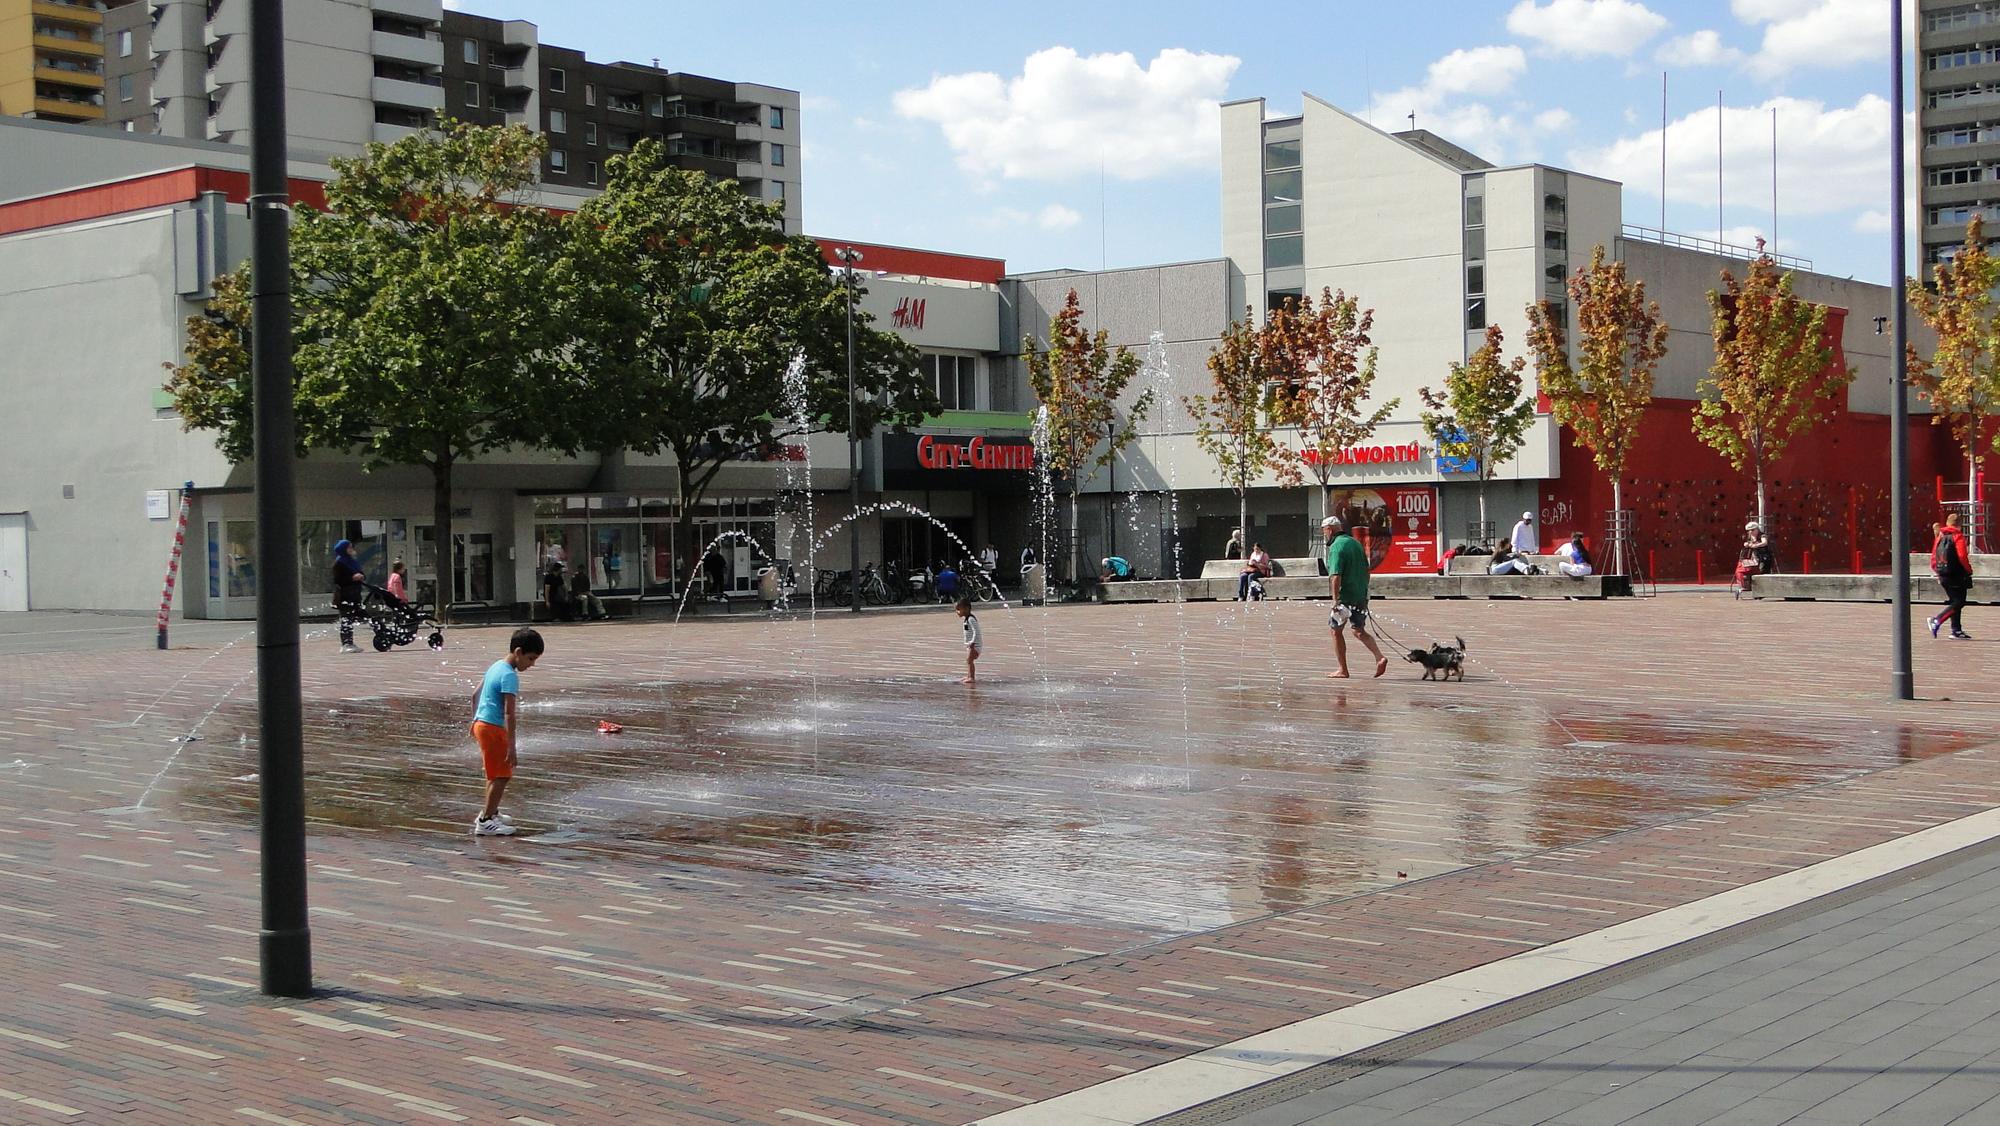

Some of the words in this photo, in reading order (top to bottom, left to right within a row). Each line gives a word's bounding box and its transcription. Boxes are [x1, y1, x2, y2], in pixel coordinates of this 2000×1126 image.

[892, 297, 926, 330] H&M
[1300, 445, 1419, 465] WOLWORTH
[1396, 494, 1430, 513] 1.000
